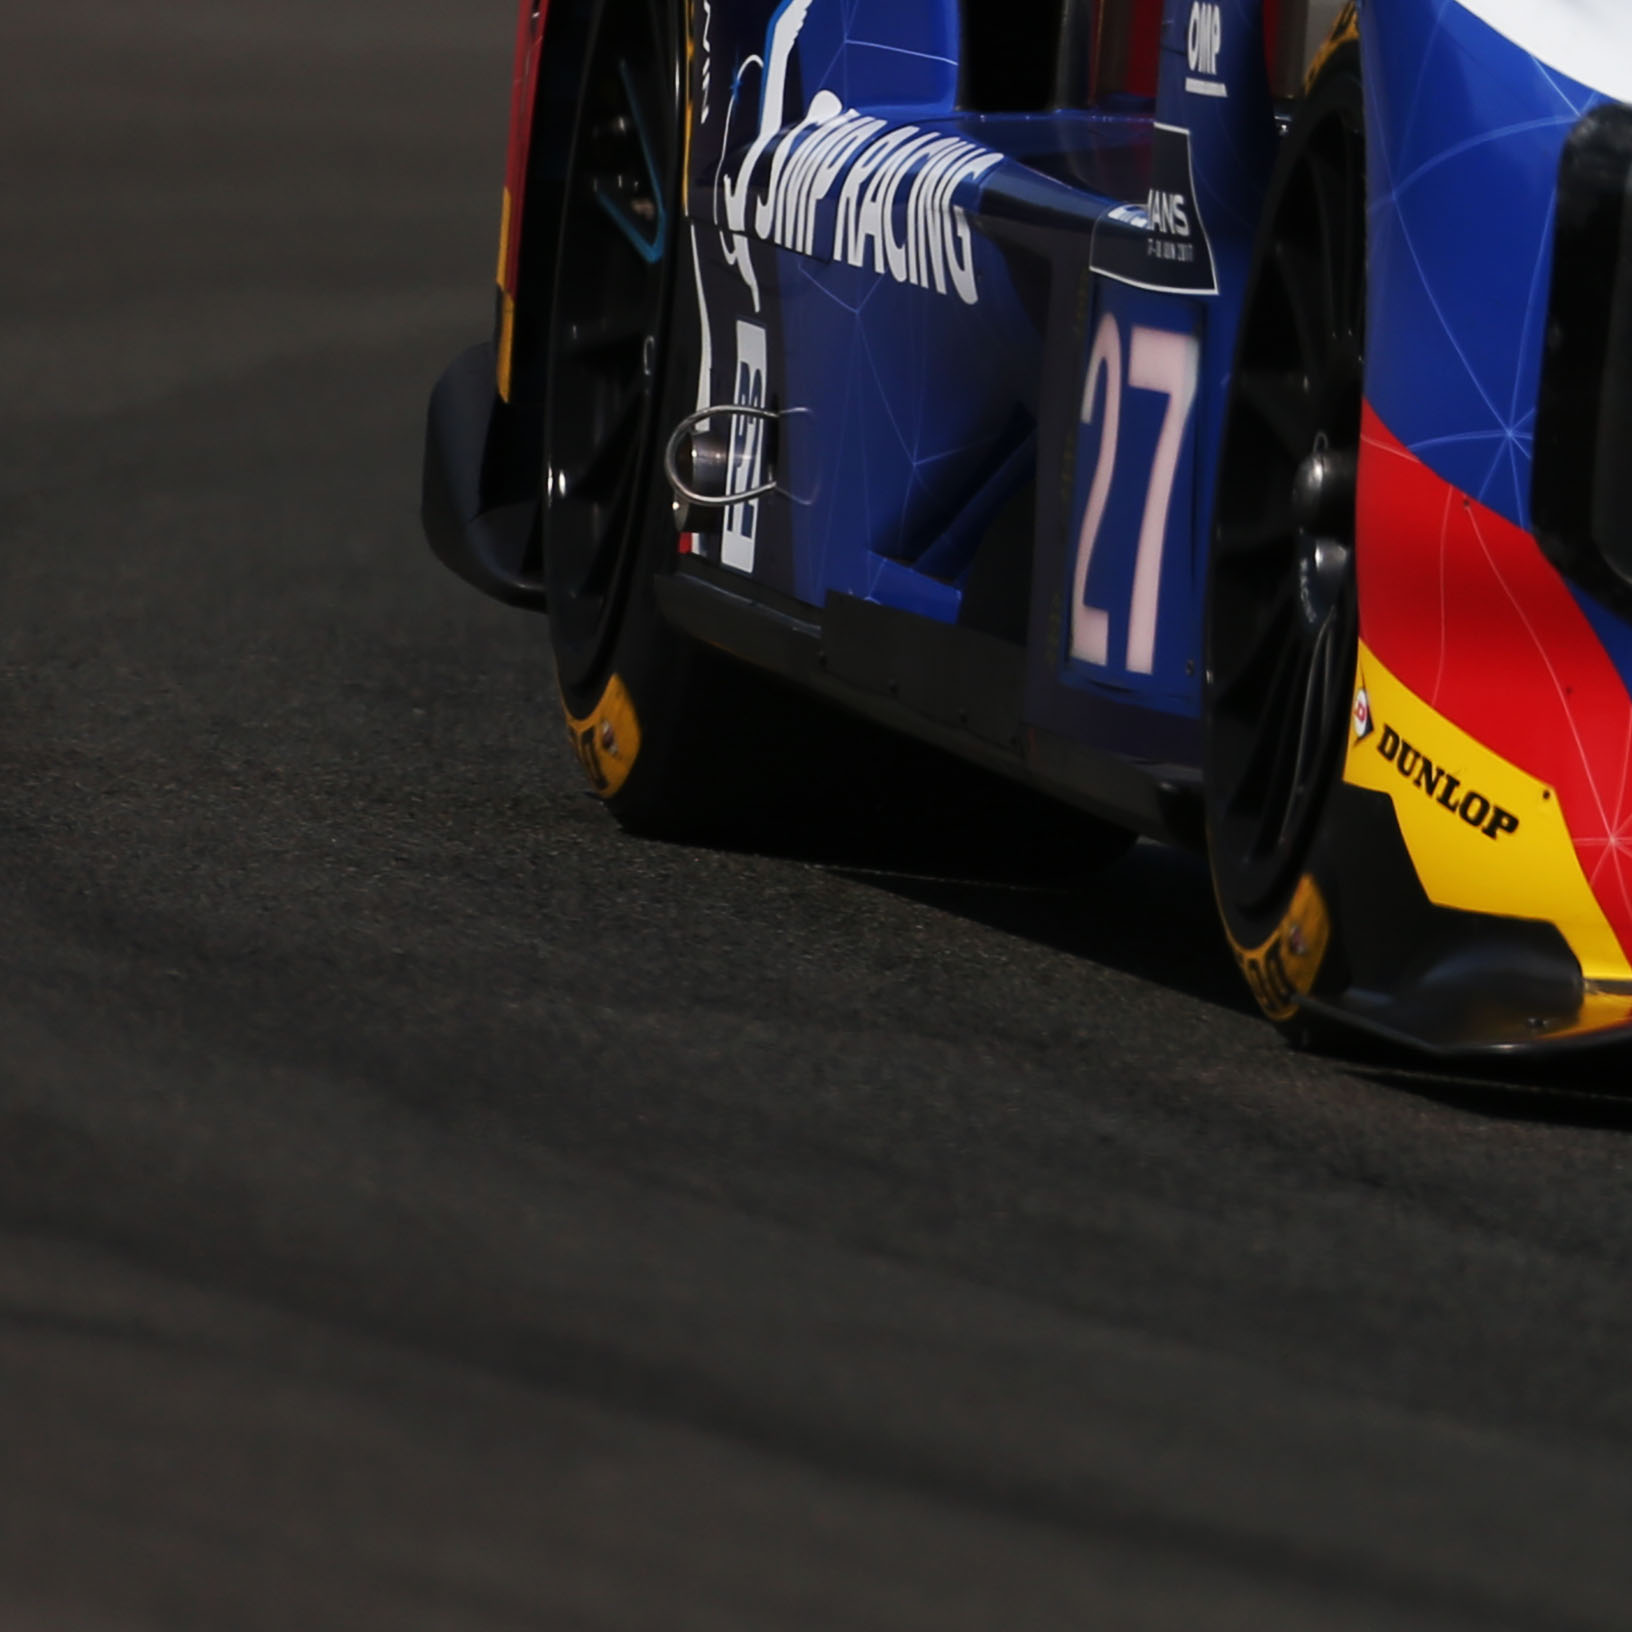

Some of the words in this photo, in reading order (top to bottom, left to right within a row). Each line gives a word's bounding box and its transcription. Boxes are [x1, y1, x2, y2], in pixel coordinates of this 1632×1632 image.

[755, 108, 888, 257] SMP
[833, 125, 1005, 306] RACING
[1069, 311, 1200, 677] 27
[1376, 721, 1520, 840] DUNLOP
